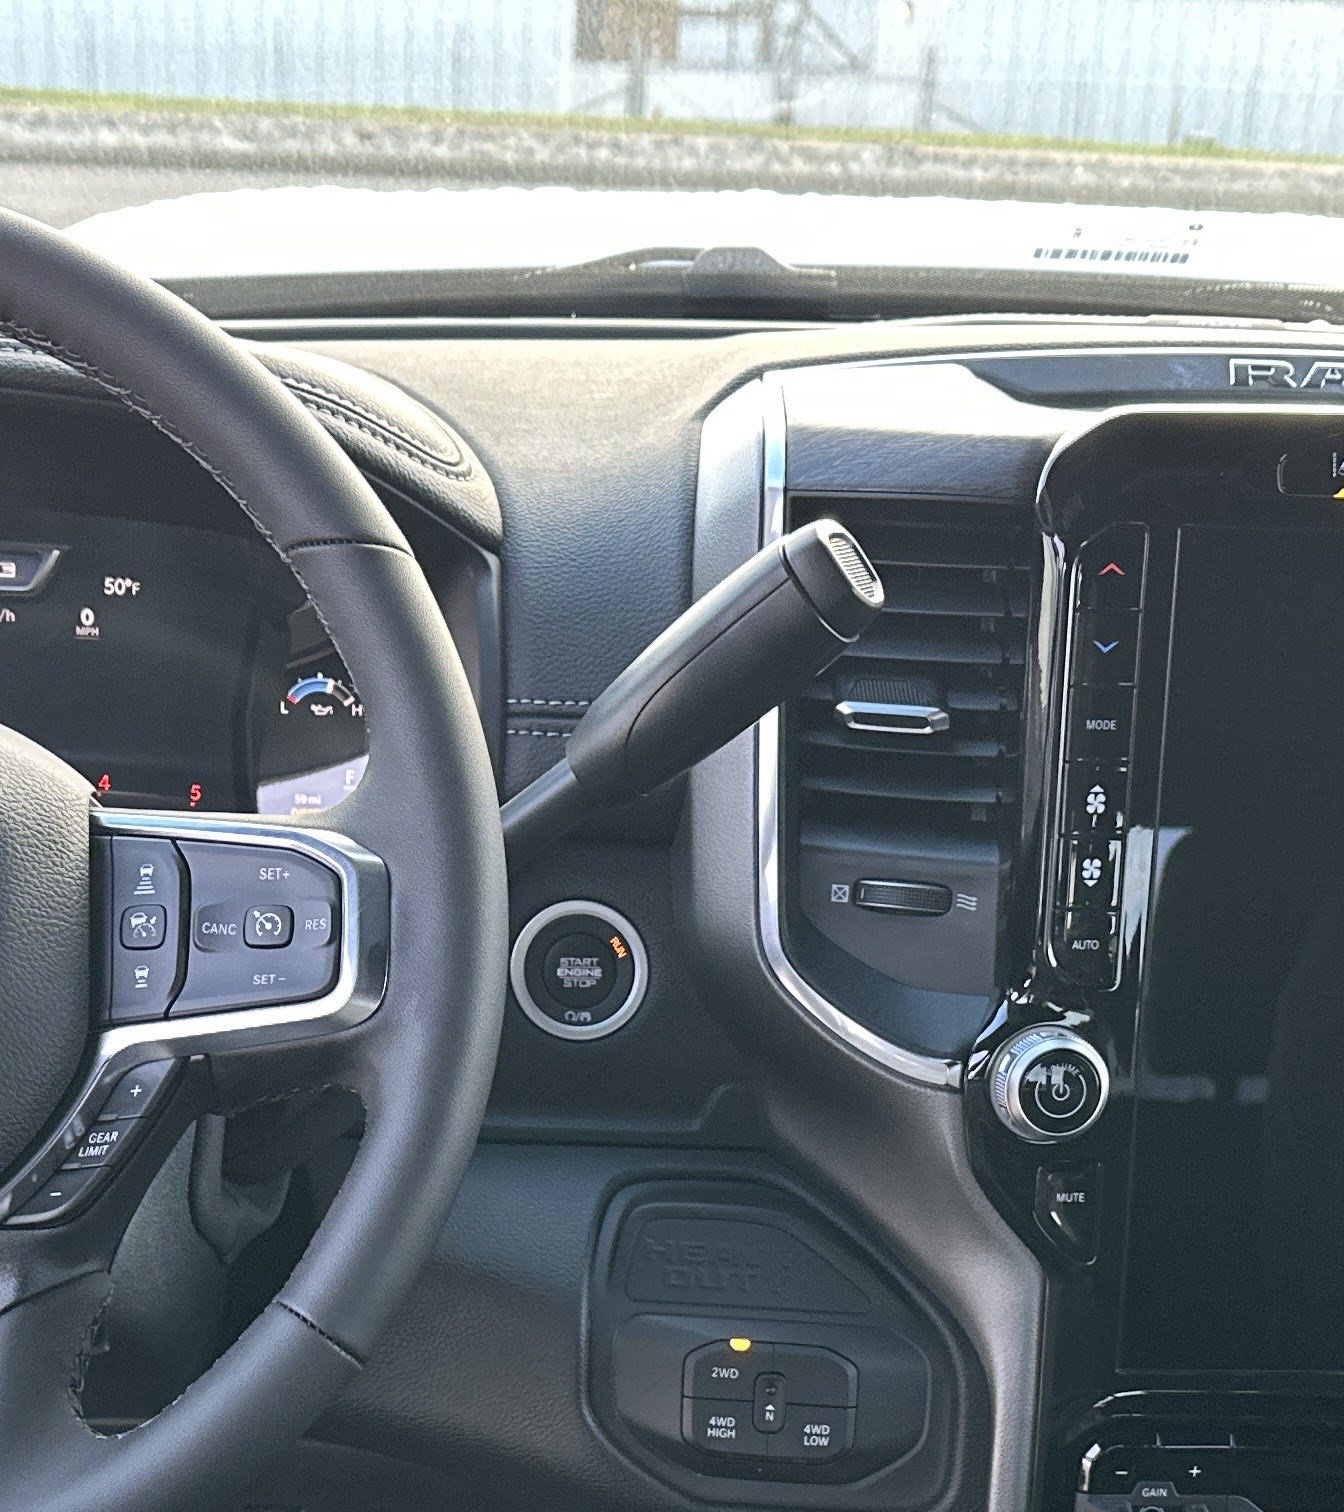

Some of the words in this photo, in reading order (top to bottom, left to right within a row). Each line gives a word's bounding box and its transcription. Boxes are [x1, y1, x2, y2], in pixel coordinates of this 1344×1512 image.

[80, 607, 95, 626] 0
[75, 625, 100, 637] MPH
[1086, 719, 1117, 731] MODE
[98, 774, 112, 791] 4
[189, 783, 202, 802] 5
[202, 922, 237, 936] CANC
[305, 917, 327, 931] RES
[609, 936, 628, 959] RUN
[1071, 939, 1100, 951] AUTO
[560, 957, 599, 967] START
[556, 967, 603, 978] ENGINE
[563, 979, 597, 988] STOP
[88, 1131, 119, 1145] GEAR
[78, 1144, 108, 1158] LIMIT
[1056, 1192, 1085, 1203] MUTE
[711, 1366, 739, 1379] 2WD
[709, 1416, 736, 1427] 4WD
[765, 1411, 774, 1421] N
[707, 1427, 736, 1439] HIGH
[803, 1424, 831, 1435] 4WD
[803, 1435, 830, 1447] LOW
[1142, 1487, 1167, 1498] GAIN
